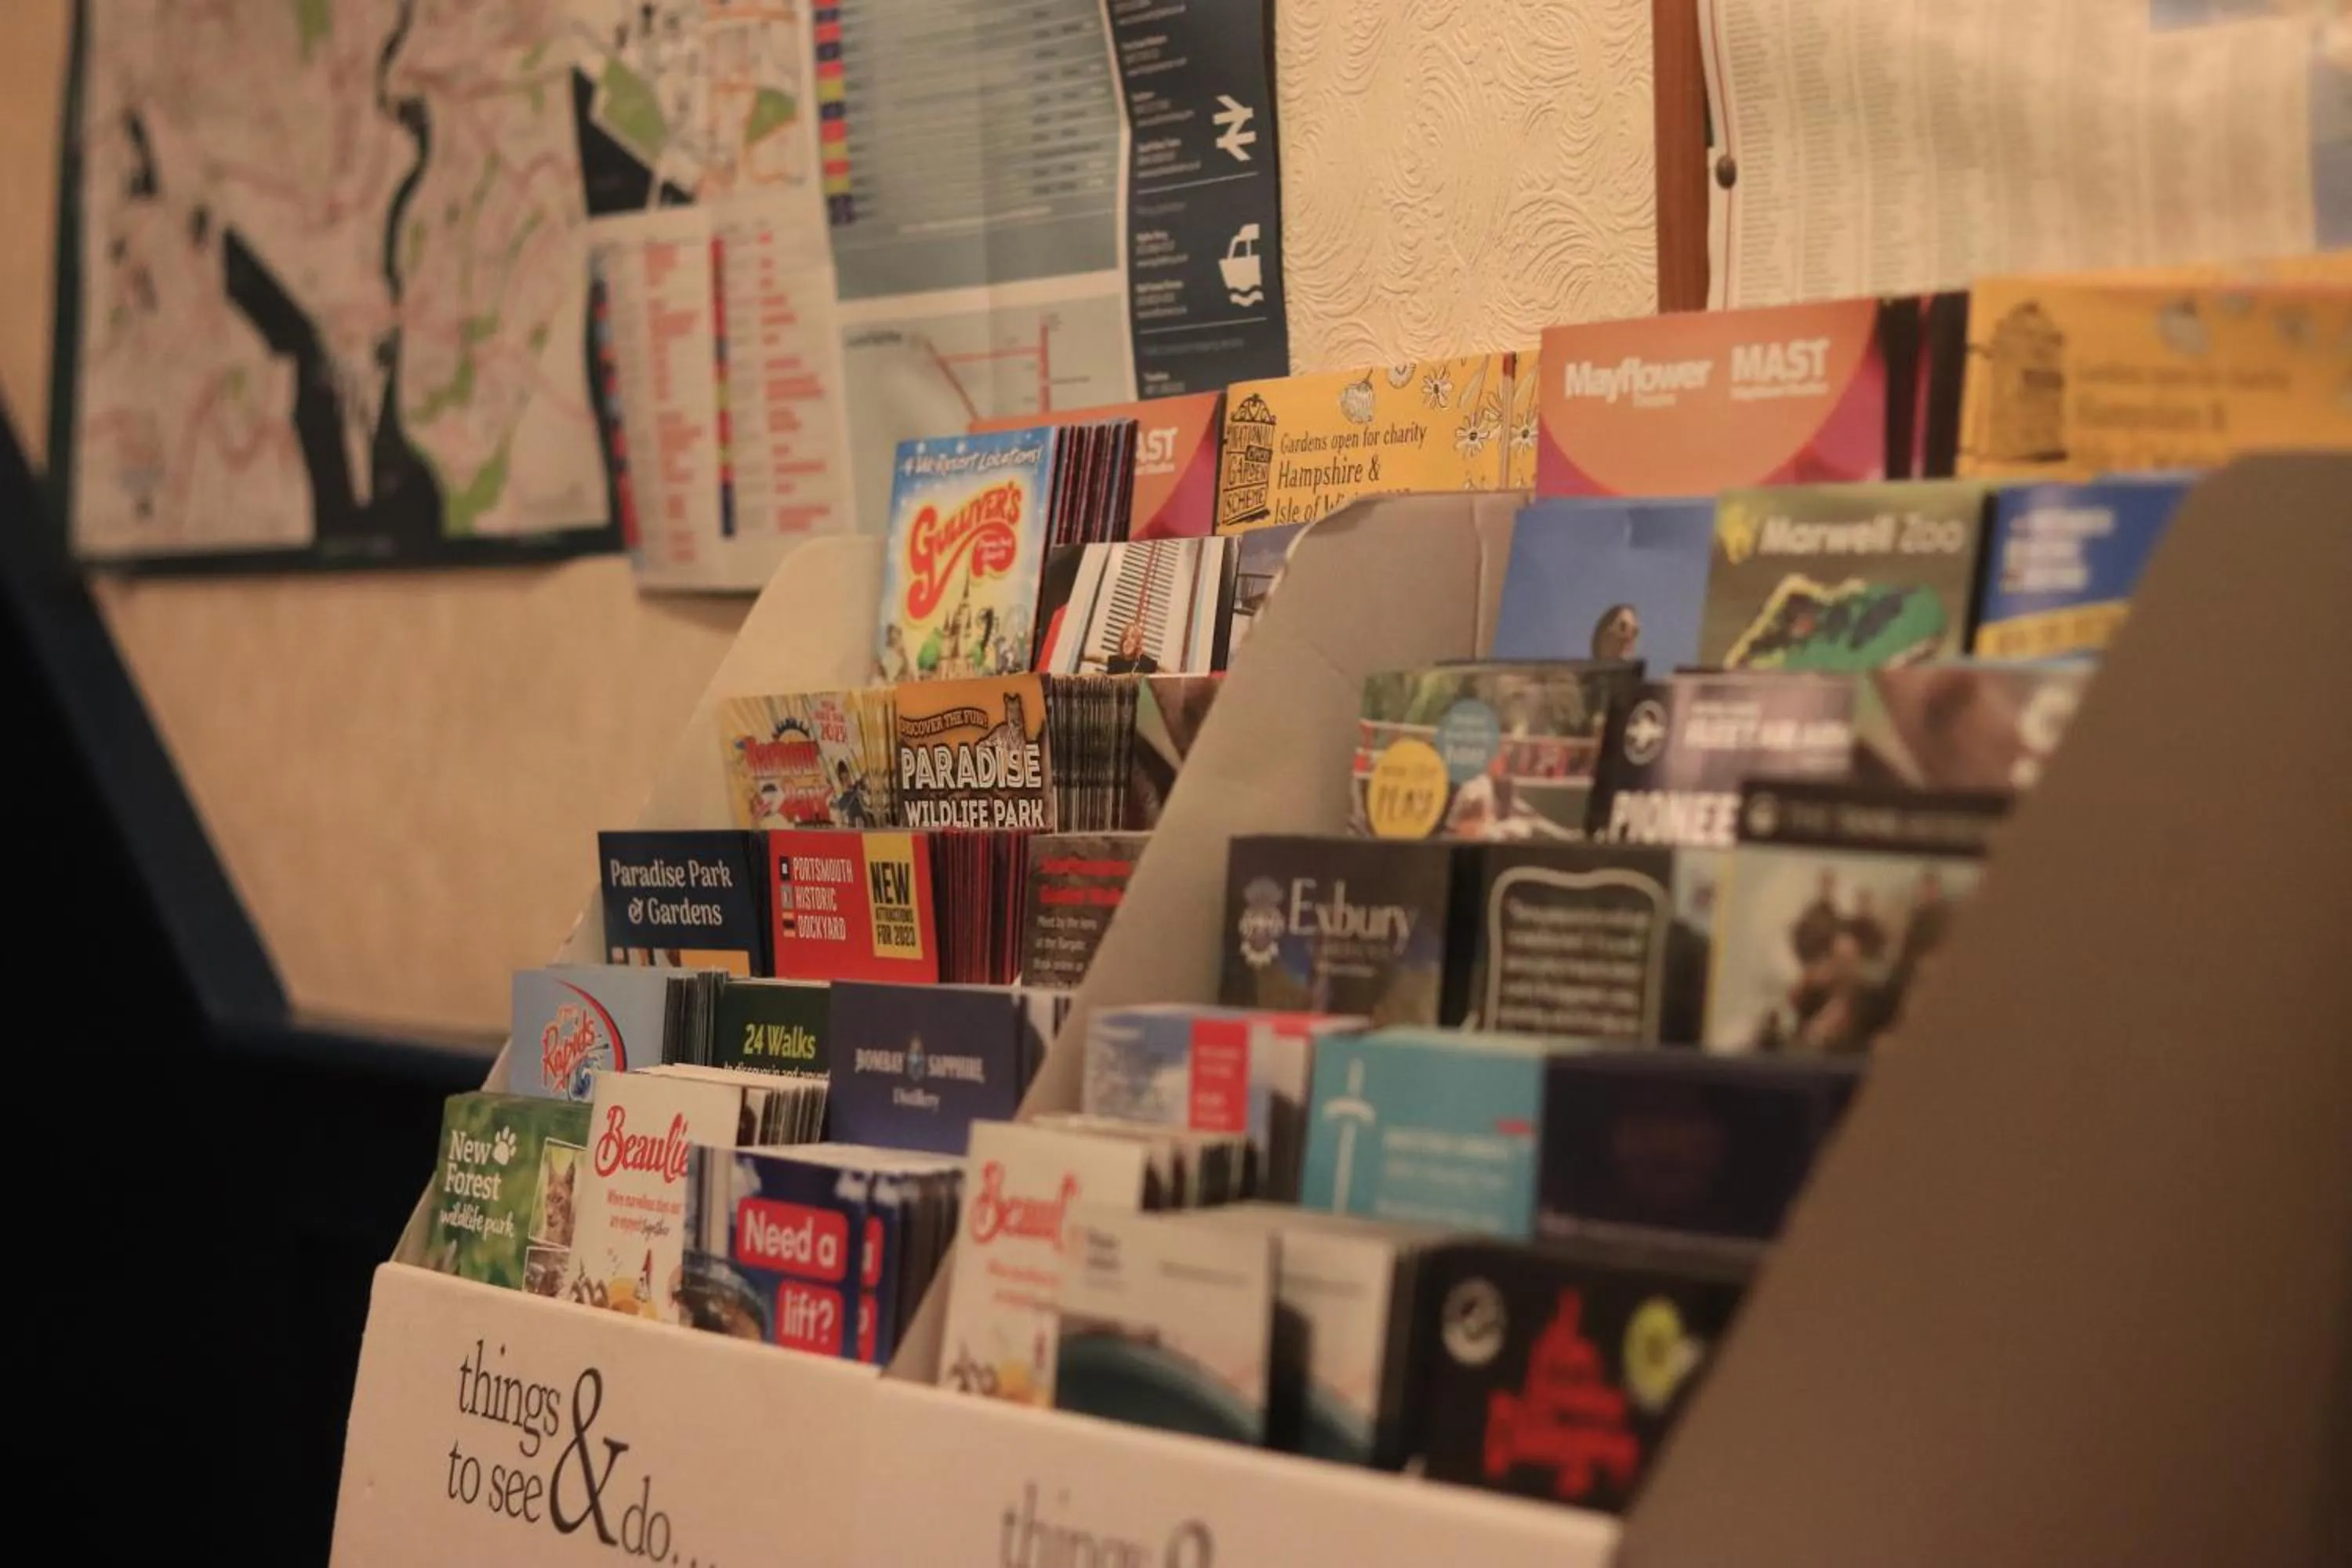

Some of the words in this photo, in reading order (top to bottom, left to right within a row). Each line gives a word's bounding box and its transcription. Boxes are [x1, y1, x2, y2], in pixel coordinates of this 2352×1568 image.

[1565, 355, 1713, 403] Mayflower
[1731, 338, 1831, 383] MAST
[1135, 426, 1178, 463] AST
[1280, 431, 1327, 455] Gardens
[1331, 434, 1359, 456] open
[1362, 426, 1381, 448] for
[1383, 423, 1428, 450] charity
[1278, 456, 1363, 494] Hampshire
[1368, 455, 1381, 482] &
[1274, 497, 1300, 524] Isle
[901, 743, 1042, 789] PARADISE
[904, 798, 989, 829] WILDLIFE
[993, 798, 1044, 828] PARK
[610, 858, 686, 887] Paradise
[688, 858, 733, 887] Park
[793, 857, 854, 884] PORTSMOUTH
[870, 862, 909, 905] NEW
[648, 897, 723, 926] Gardens
[794, 885, 837, 911] HISTORIC
[797, 915, 847, 941] DOCKYARD
[877, 924, 892, 945] FOR
[1290, 877, 1418, 956] Exbury
[743, 1023, 764, 1054] 24
[768, 1025, 816, 1059] Walks
[855, 1047, 905, 1074] BOMBAY
[448, 1129, 492, 1165] New
[444, 1163, 502, 1201] Forest
[481, 1210, 514, 1241] park
[745, 1209, 814, 1263] Need
[817, 1234, 837, 1269] a
[783, 1290, 833, 1344] lift?
[459, 1339, 561, 1457] things
[448, 1437, 481, 1504] to
[488, 1464, 543, 1523] see
[550, 1367, 630, 1547] &
